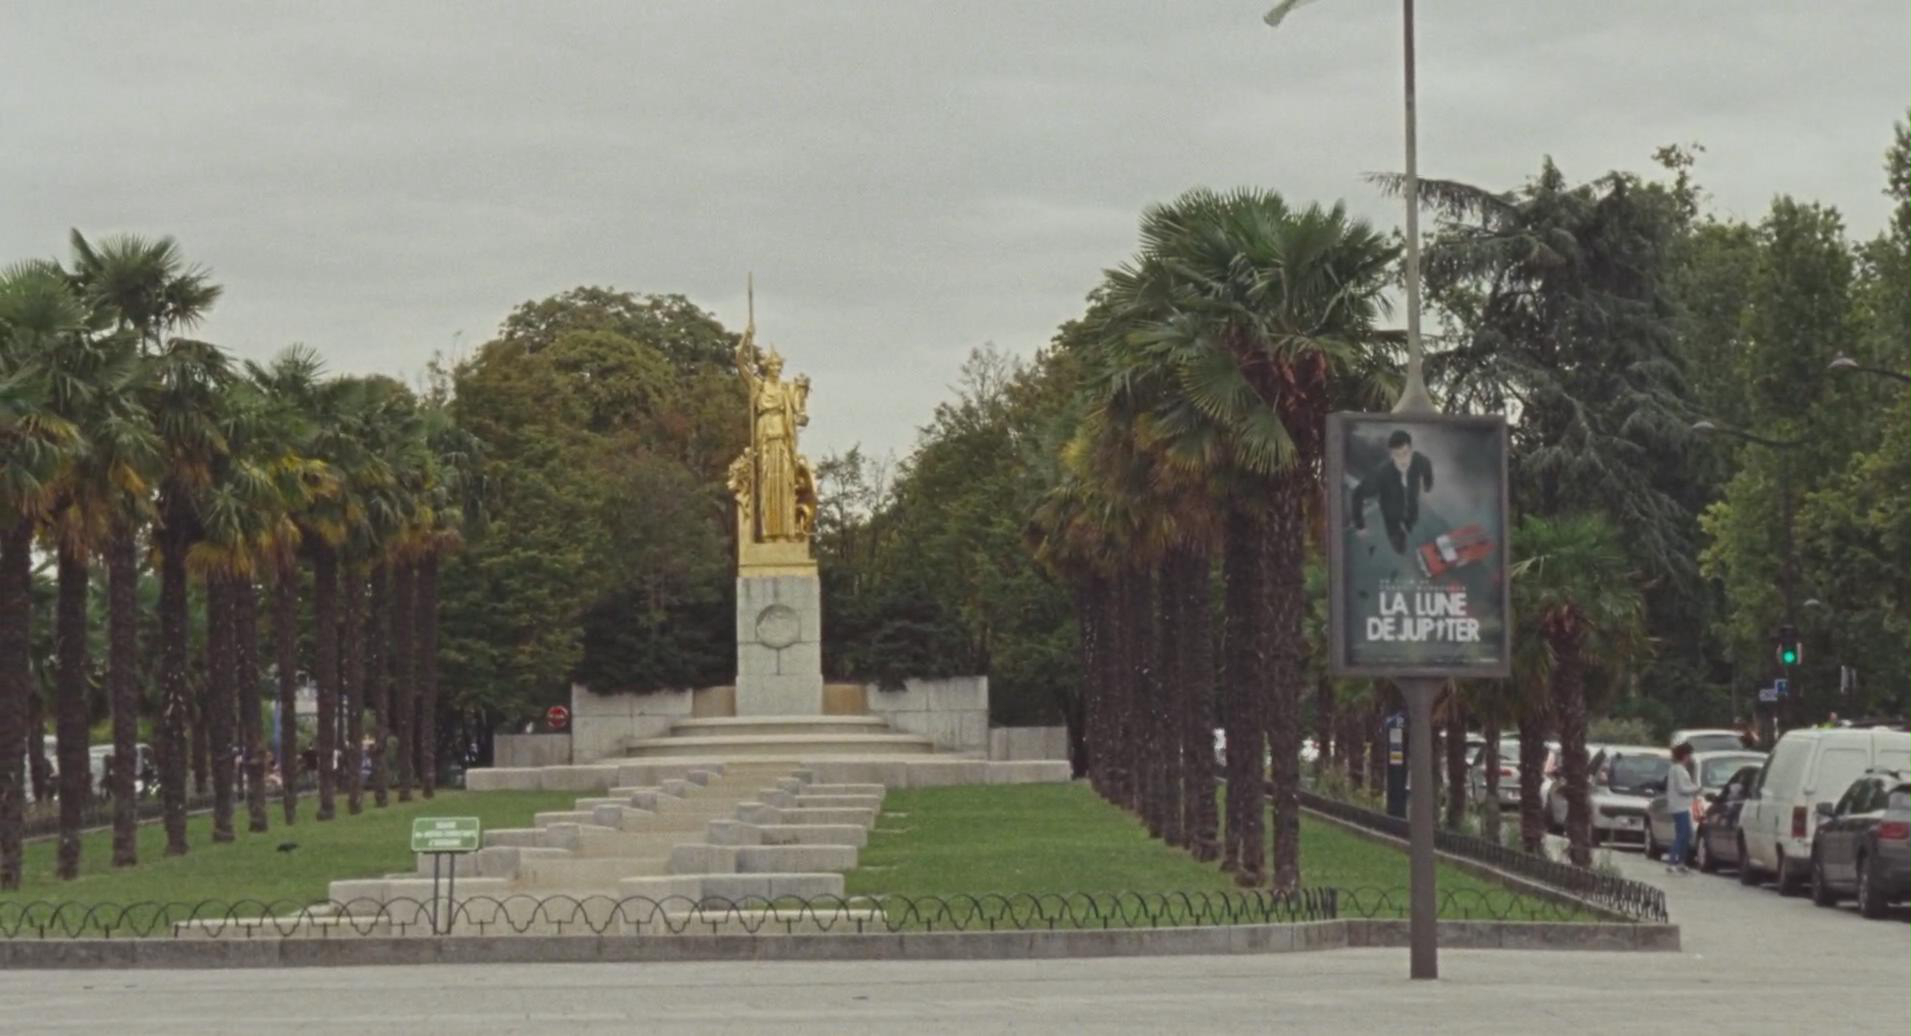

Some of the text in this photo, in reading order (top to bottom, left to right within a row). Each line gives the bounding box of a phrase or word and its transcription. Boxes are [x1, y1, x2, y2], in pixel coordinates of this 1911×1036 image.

[1379, 592, 1467, 616] LA LUNE
[1366, 616, 1480, 642] DE JUPITER
